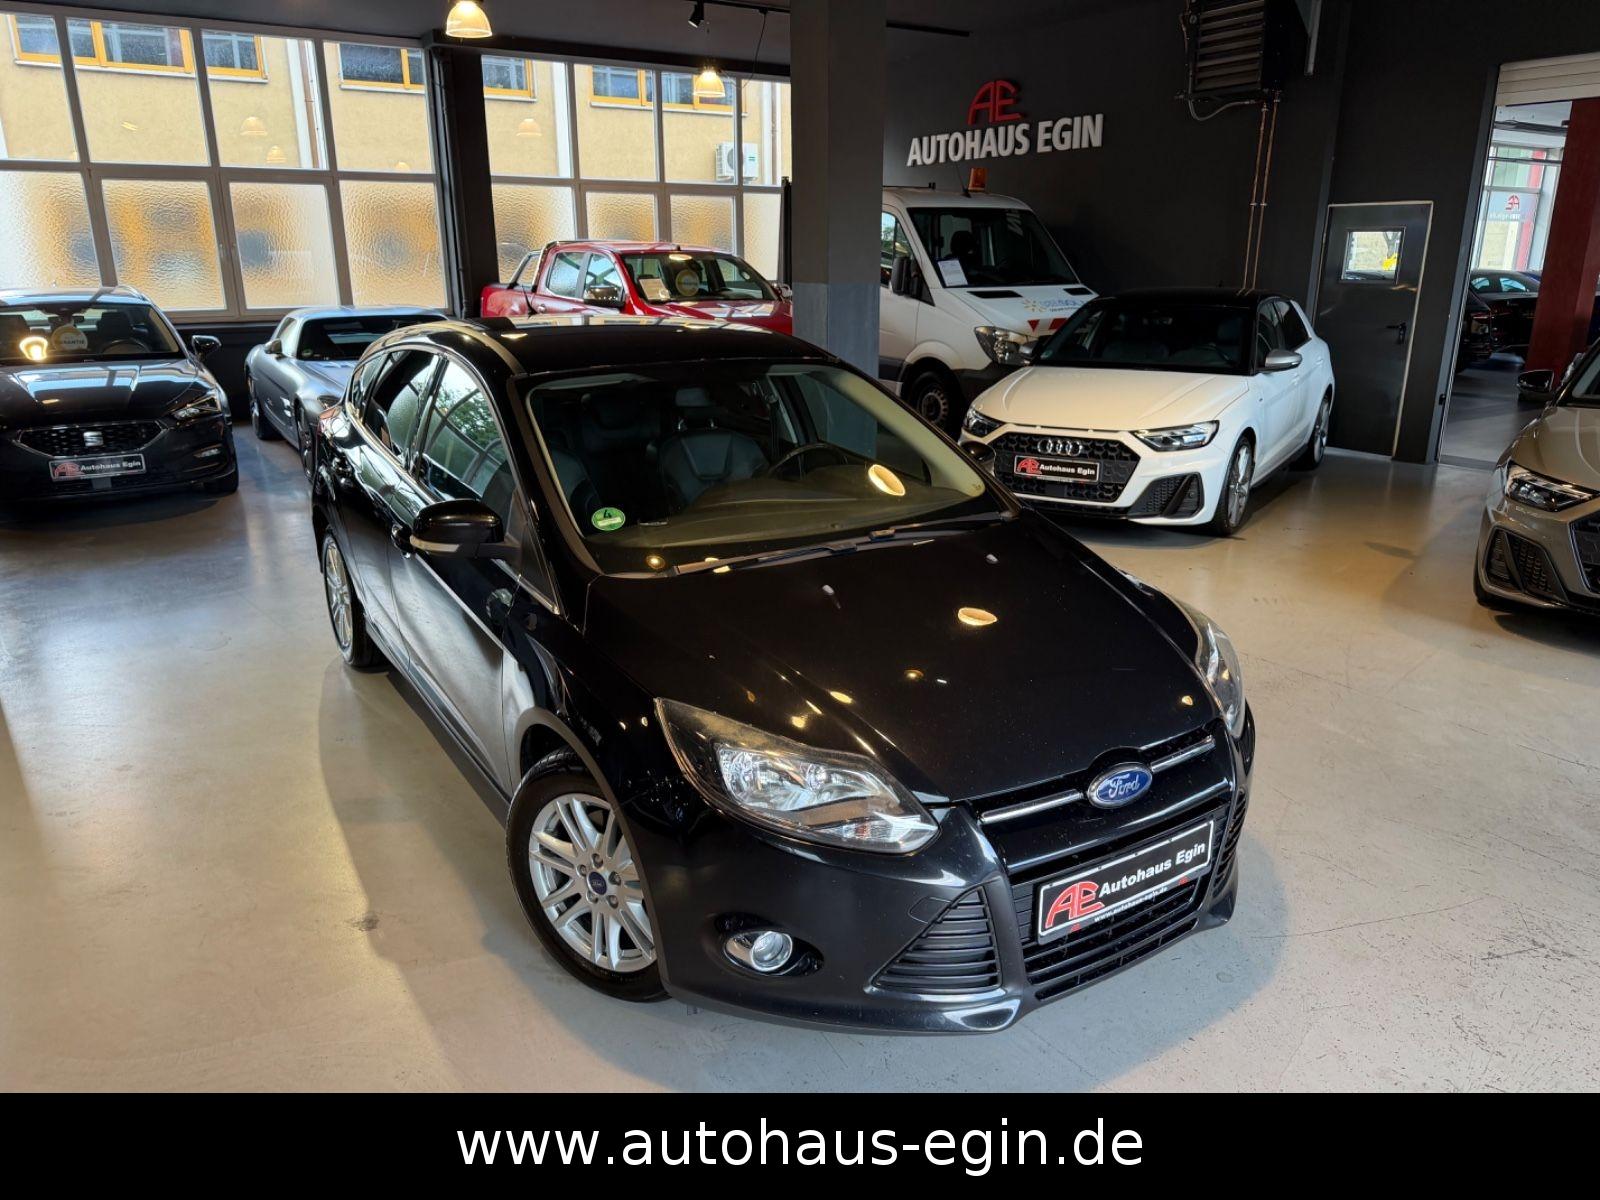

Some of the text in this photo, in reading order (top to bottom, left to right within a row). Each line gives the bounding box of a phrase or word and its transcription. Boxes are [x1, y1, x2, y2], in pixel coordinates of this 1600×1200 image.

[906, 113, 1104, 167] AUTOHAUS EGIN
[1040, 464, 1075, 474] Autohaus
[1077, 468, 1095, 476] Egin
[1108, 773, 1140, 798] Ford
[1098, 859, 1172, 898] Autohaus
[1175, 842, 1206, 865] Egin
